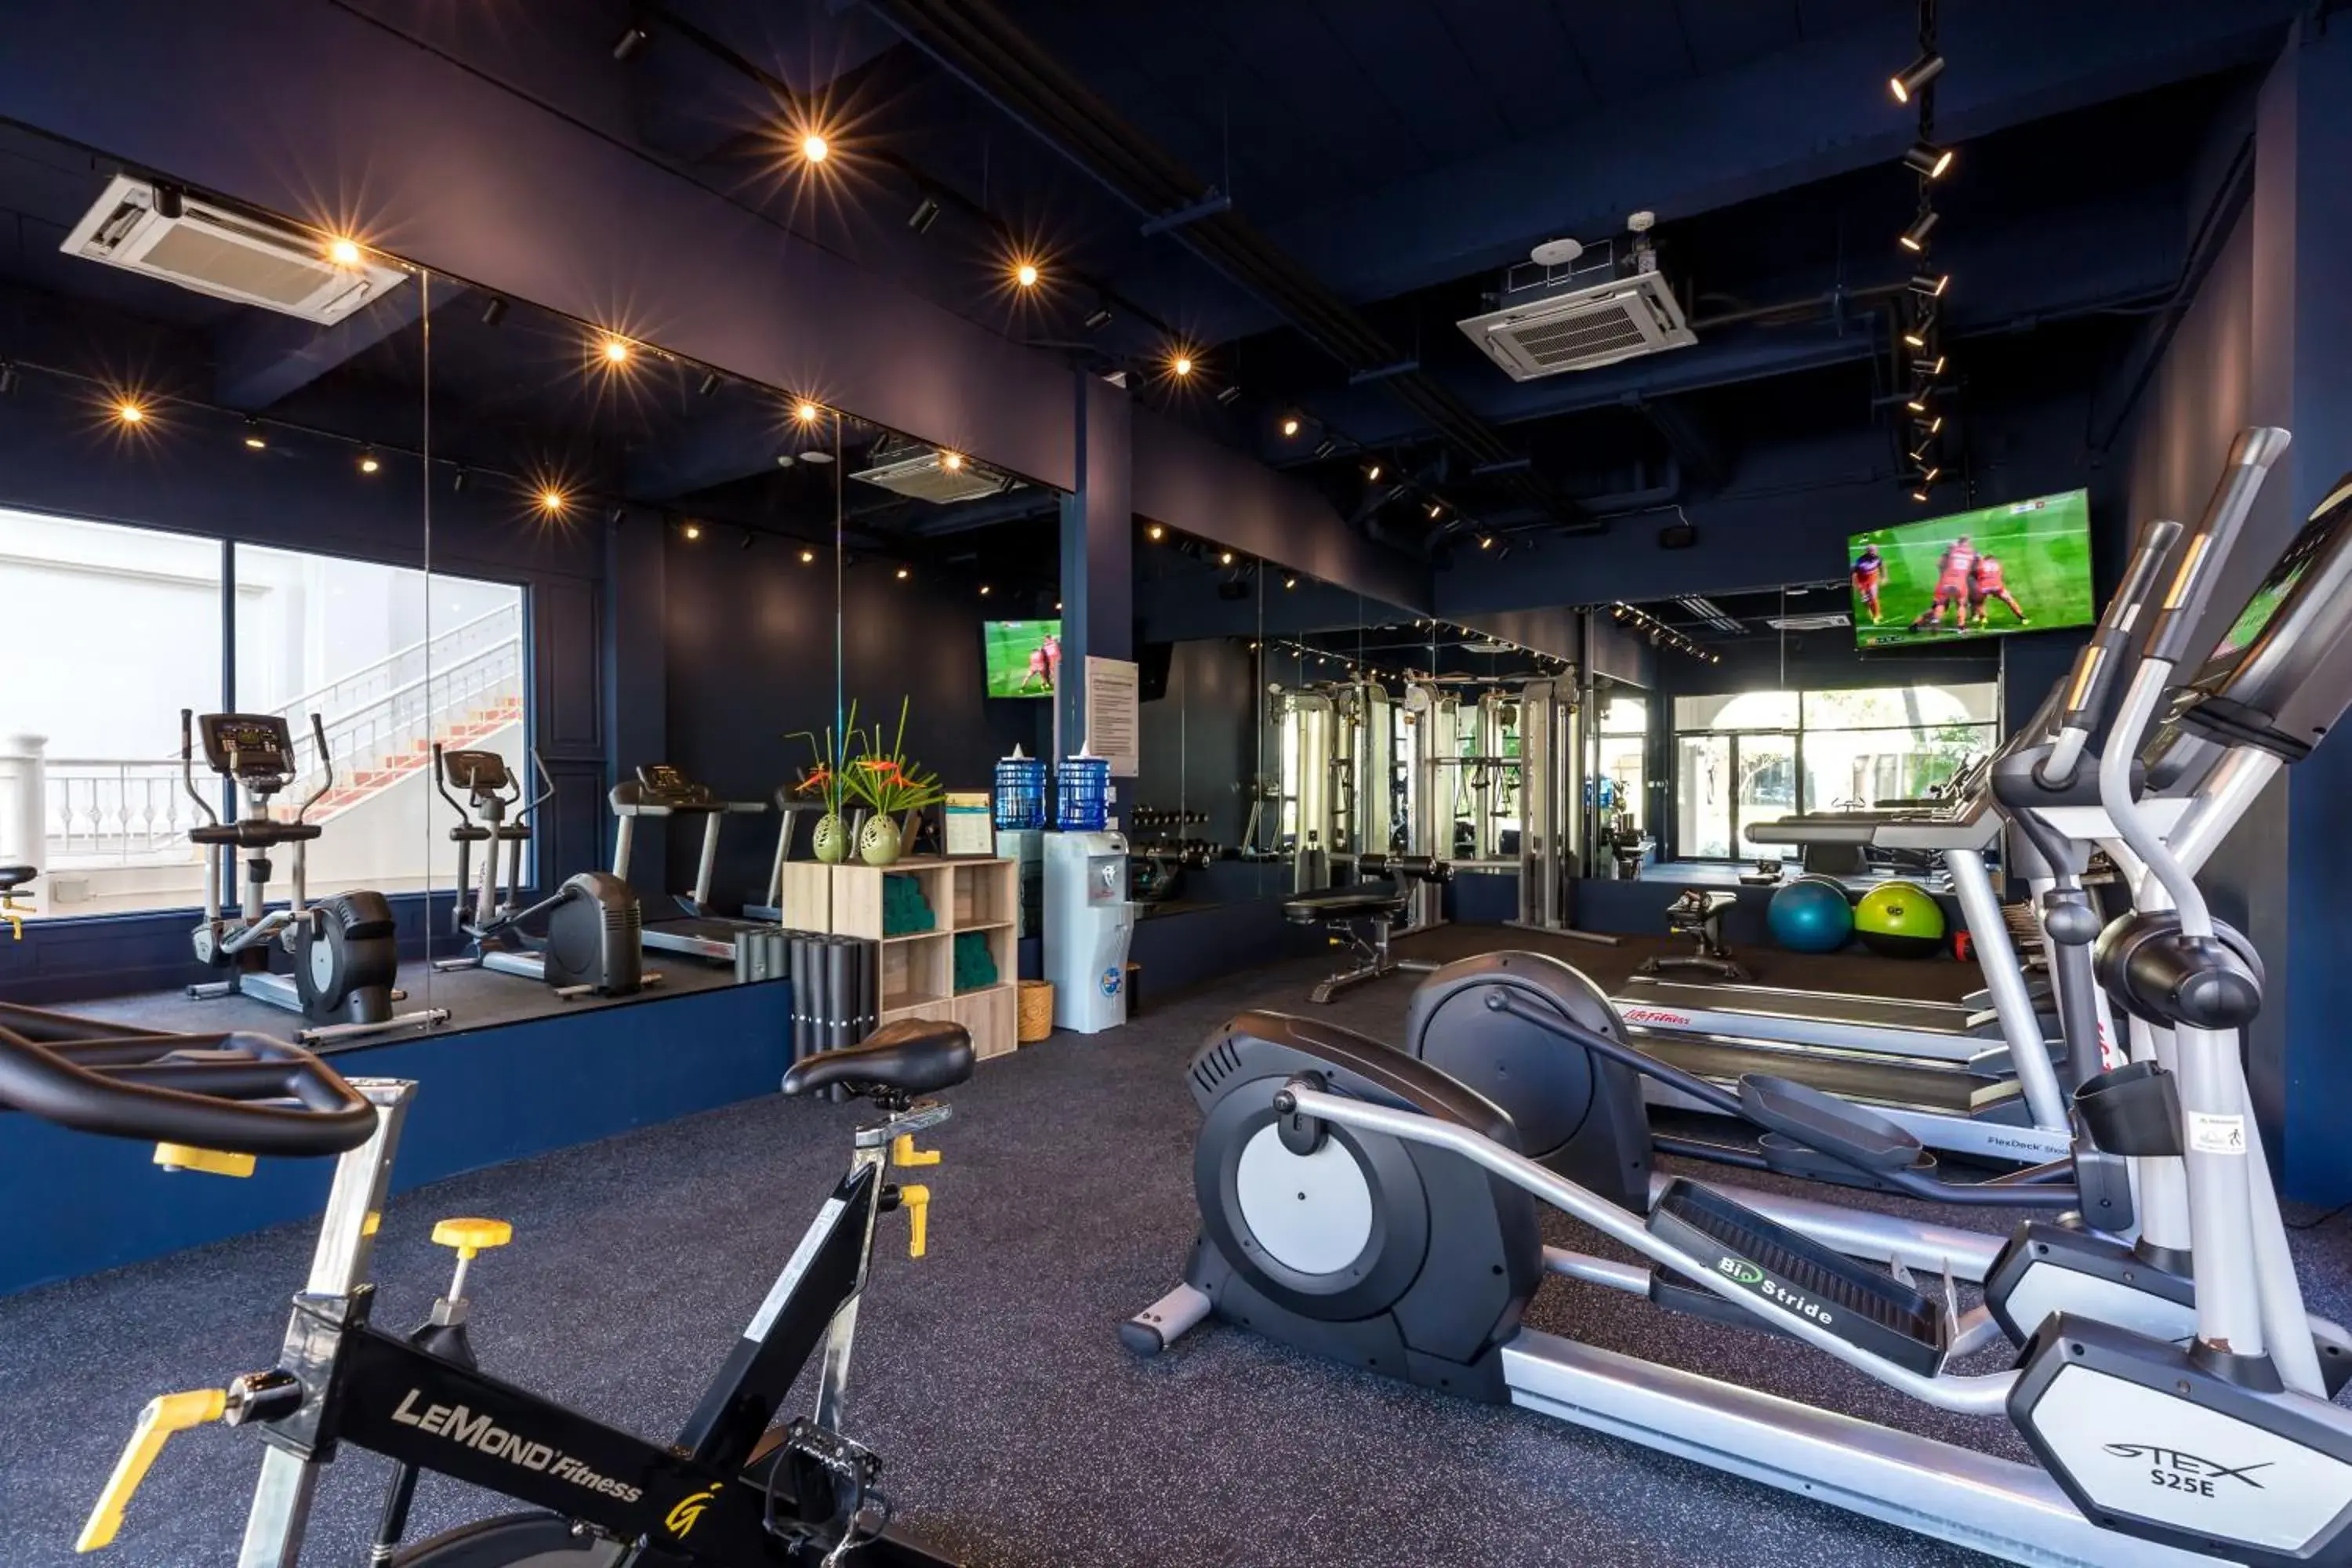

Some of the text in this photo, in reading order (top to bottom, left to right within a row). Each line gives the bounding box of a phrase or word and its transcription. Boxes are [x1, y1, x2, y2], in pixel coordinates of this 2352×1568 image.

[1719, 1257, 1832, 1325] Bio Stride
[549, 1456, 643, 1504] Fitness
[2101, 1443, 2275, 1489] STEX
[2151, 1468, 2215, 1498] S25E
